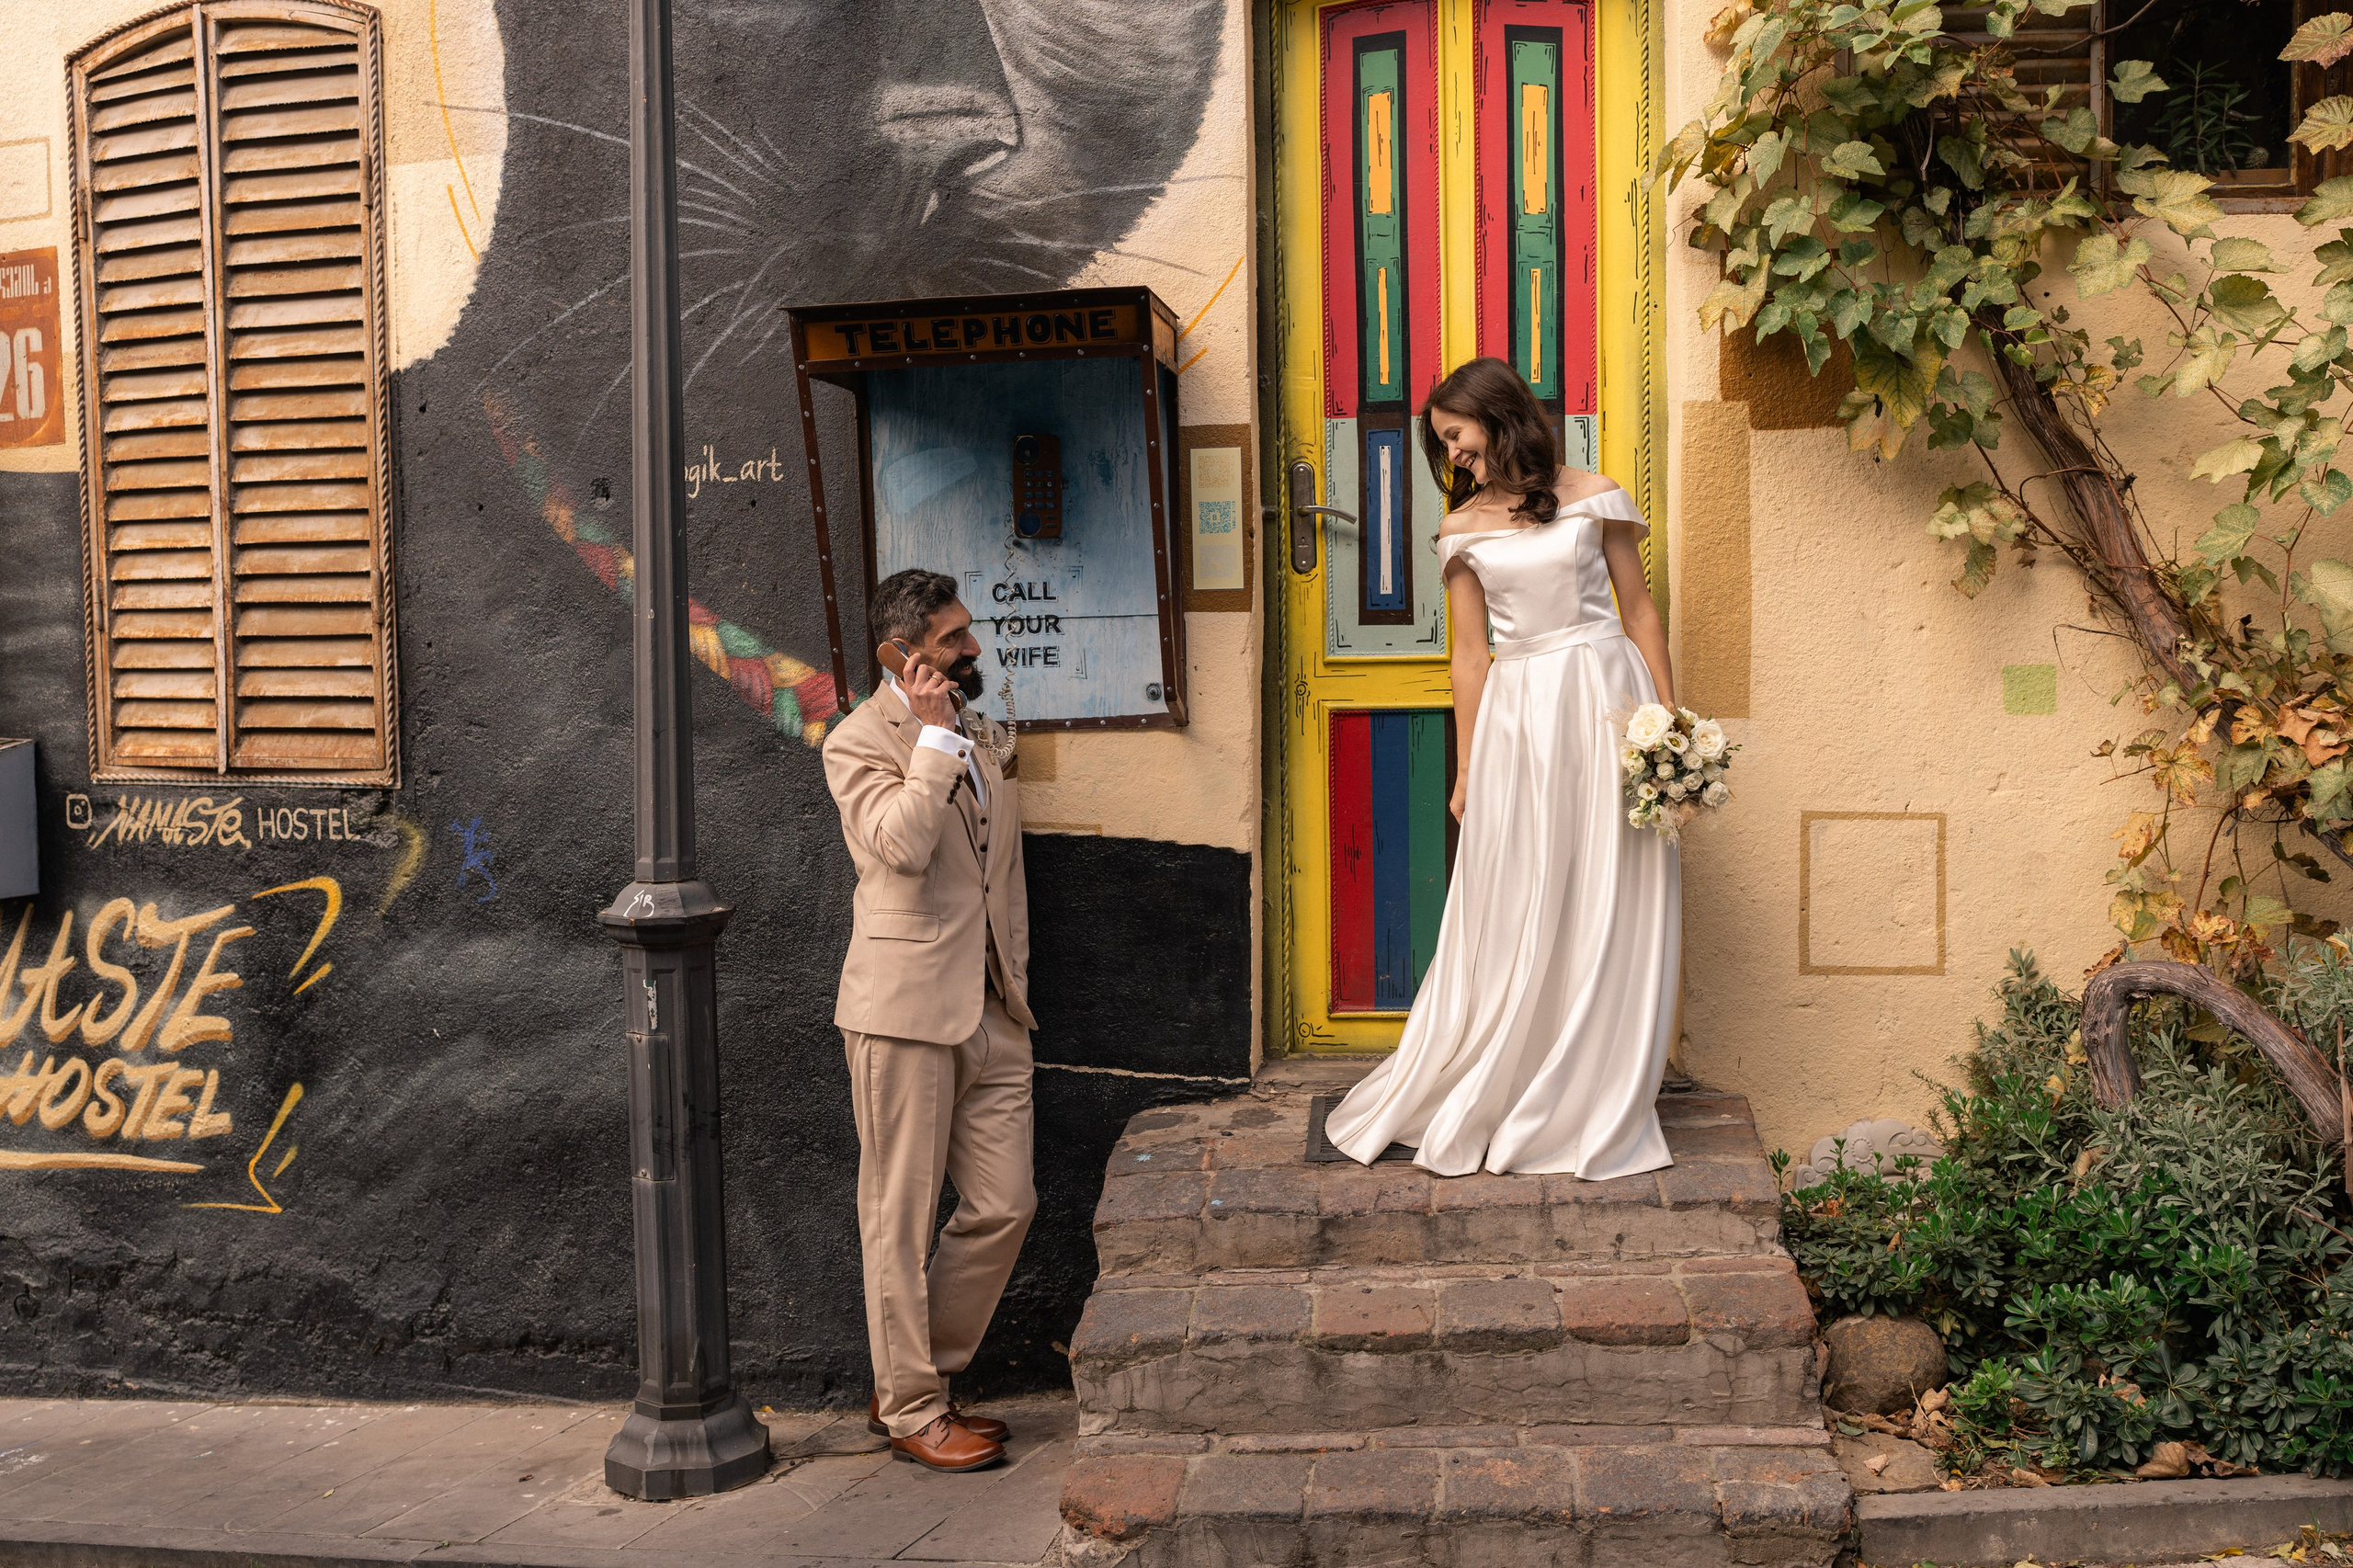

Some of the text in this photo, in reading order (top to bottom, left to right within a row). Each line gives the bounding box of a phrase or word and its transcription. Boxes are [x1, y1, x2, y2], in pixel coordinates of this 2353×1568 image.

[835, 309, 1118, 356] TELEPHONE
[992, 581, 1059, 605] CALL
[990, 614, 1064, 638] YOUR
[996, 645, 1061, 668] WIFE
[257, 806, 361, 841] HOSTEL
[0, 1050, 234, 1140] HOSTEL
